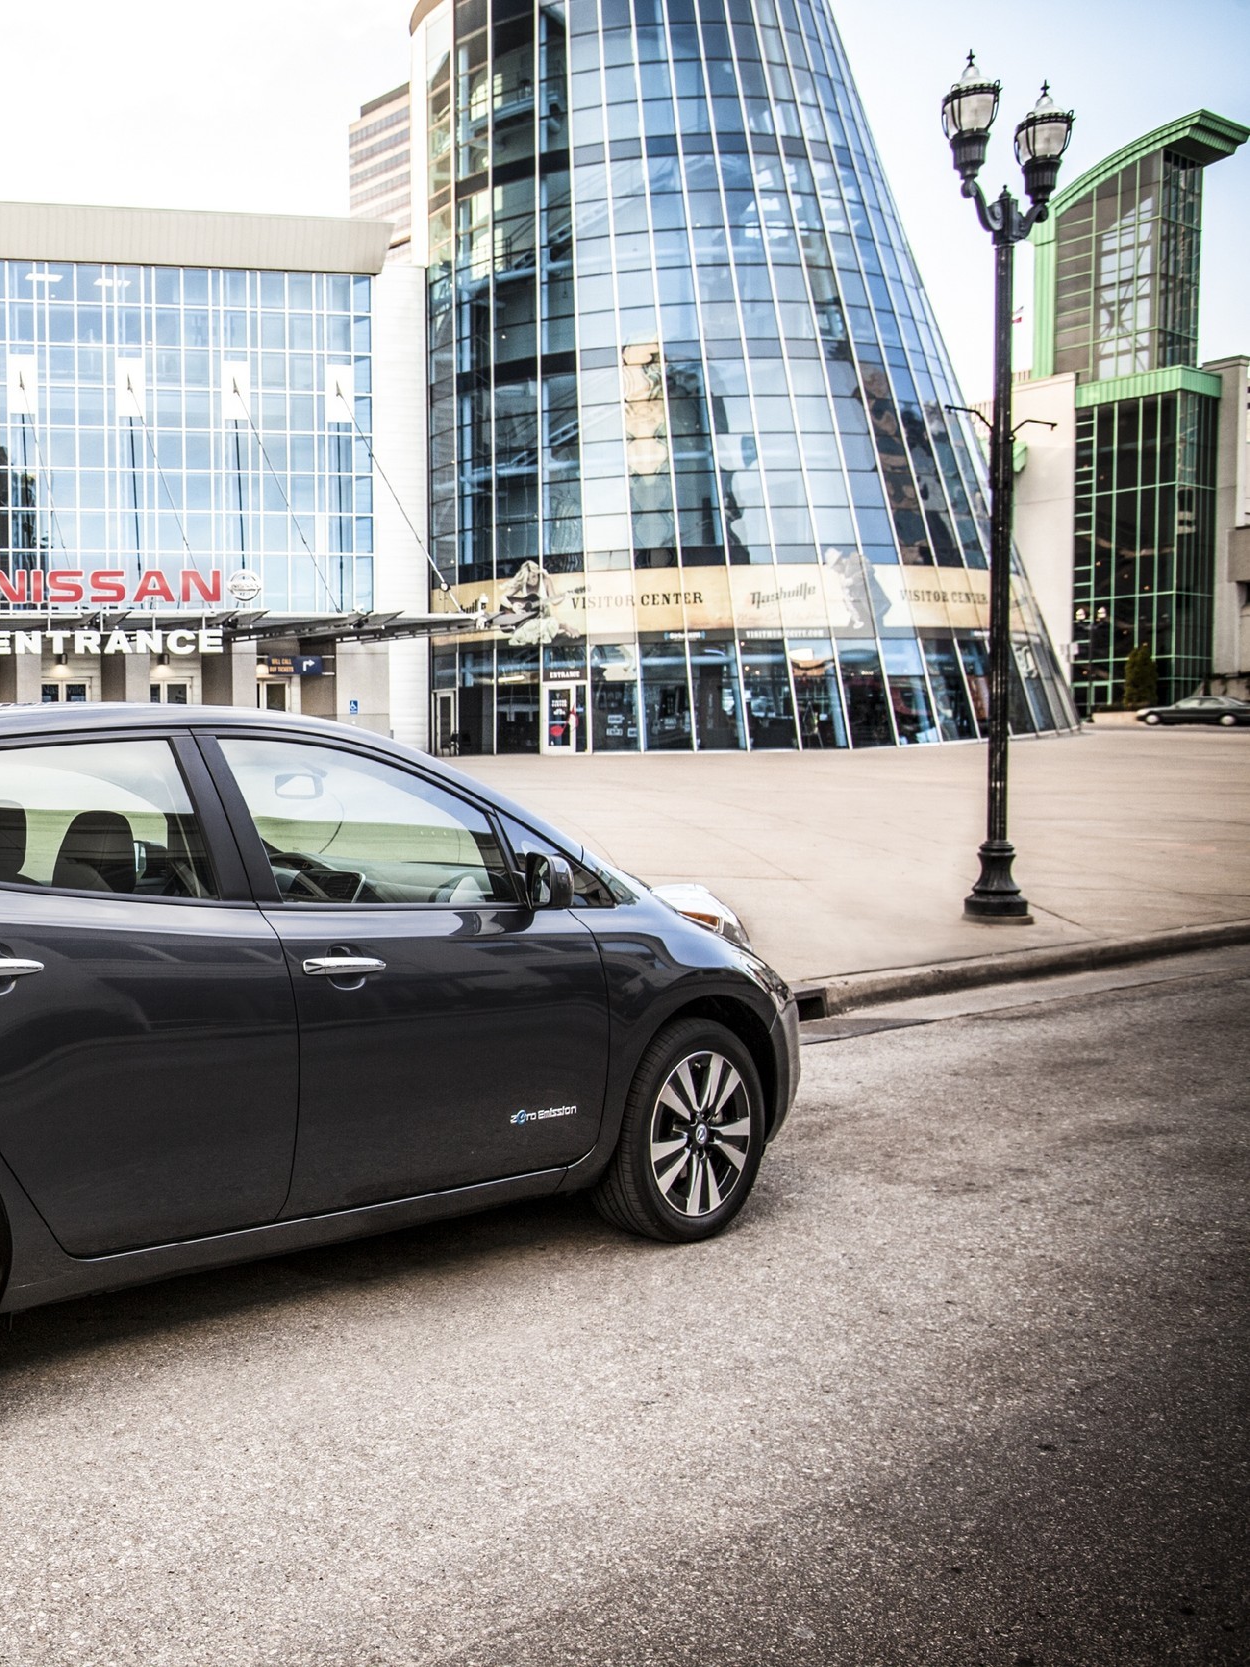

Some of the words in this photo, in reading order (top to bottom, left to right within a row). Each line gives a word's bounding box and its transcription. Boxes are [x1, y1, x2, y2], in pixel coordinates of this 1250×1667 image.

[572, 594, 636, 610] VISITOR
[641, 591, 704, 606] CENTER
[750, 582, 817, 609] Nashville
[899, 589, 949, 603] VISITOR
[951, 590, 989, 604] CENTER
[537, 1105, 577, 1120] Emission
